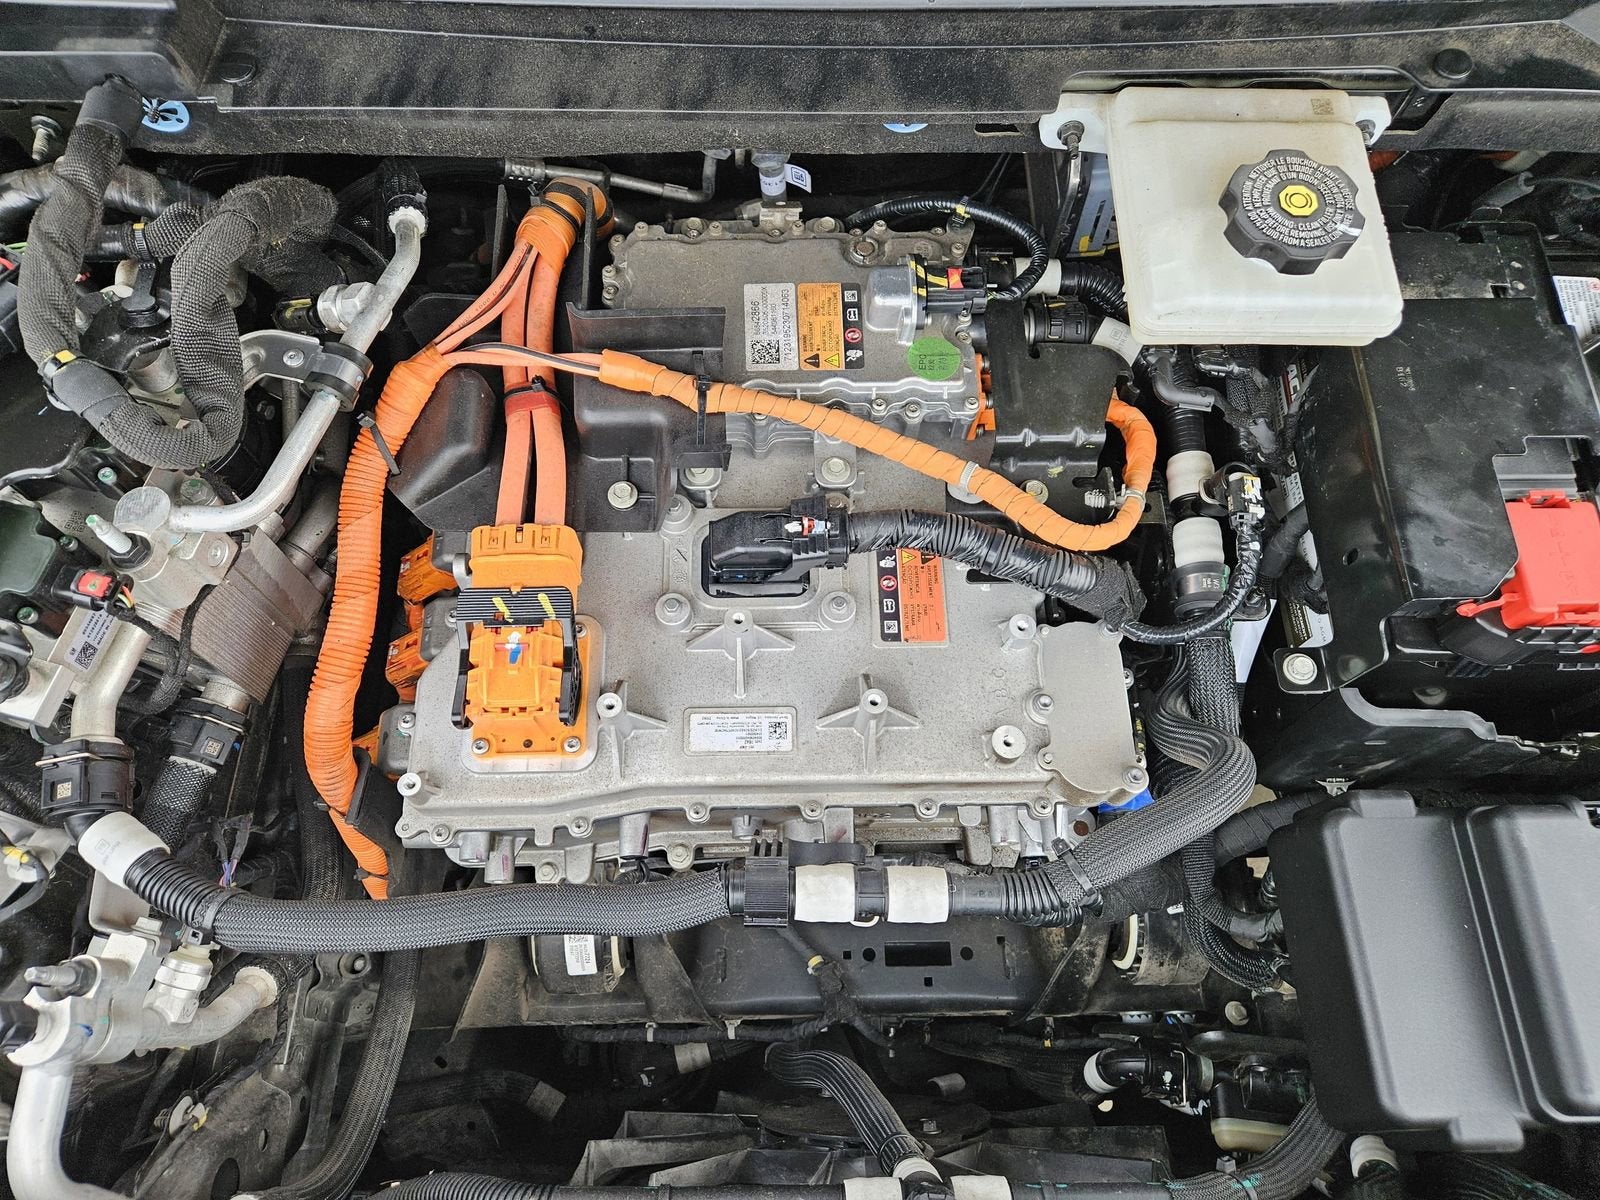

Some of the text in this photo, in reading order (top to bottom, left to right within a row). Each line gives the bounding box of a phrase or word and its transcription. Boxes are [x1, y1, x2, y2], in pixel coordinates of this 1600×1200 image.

[1248, 159, 1276, 179] NETTOYER
[1286, 156, 1318, 168] BOUCHON
[1318, 165, 1338, 182] AVANT
[1264, 168, 1278, 178] QUE
[1288, 164, 1314, 175] LIQUIDE
[1314, 171, 1323, 180] DE
[1323, 177, 1339, 194] FREIN
[1262, 172, 1335, 206] PROVENANT D'UN BIDON SCELLE
[1247, 212, 1262, 229] DOT4
[1259, 224, 1279, 239] FLUID
[1278, 234, 1300, 246] FROM
[1305, 236, 1331, 247] SEALED
[1256, 209, 1268, 220] CAP
[1265, 218, 1291, 235] BEFORE
[1324, 222, 1336, 233] USE
[1298, 221, 1321, 231] CLEAN
[1318, 207, 1333, 226] FILLER
